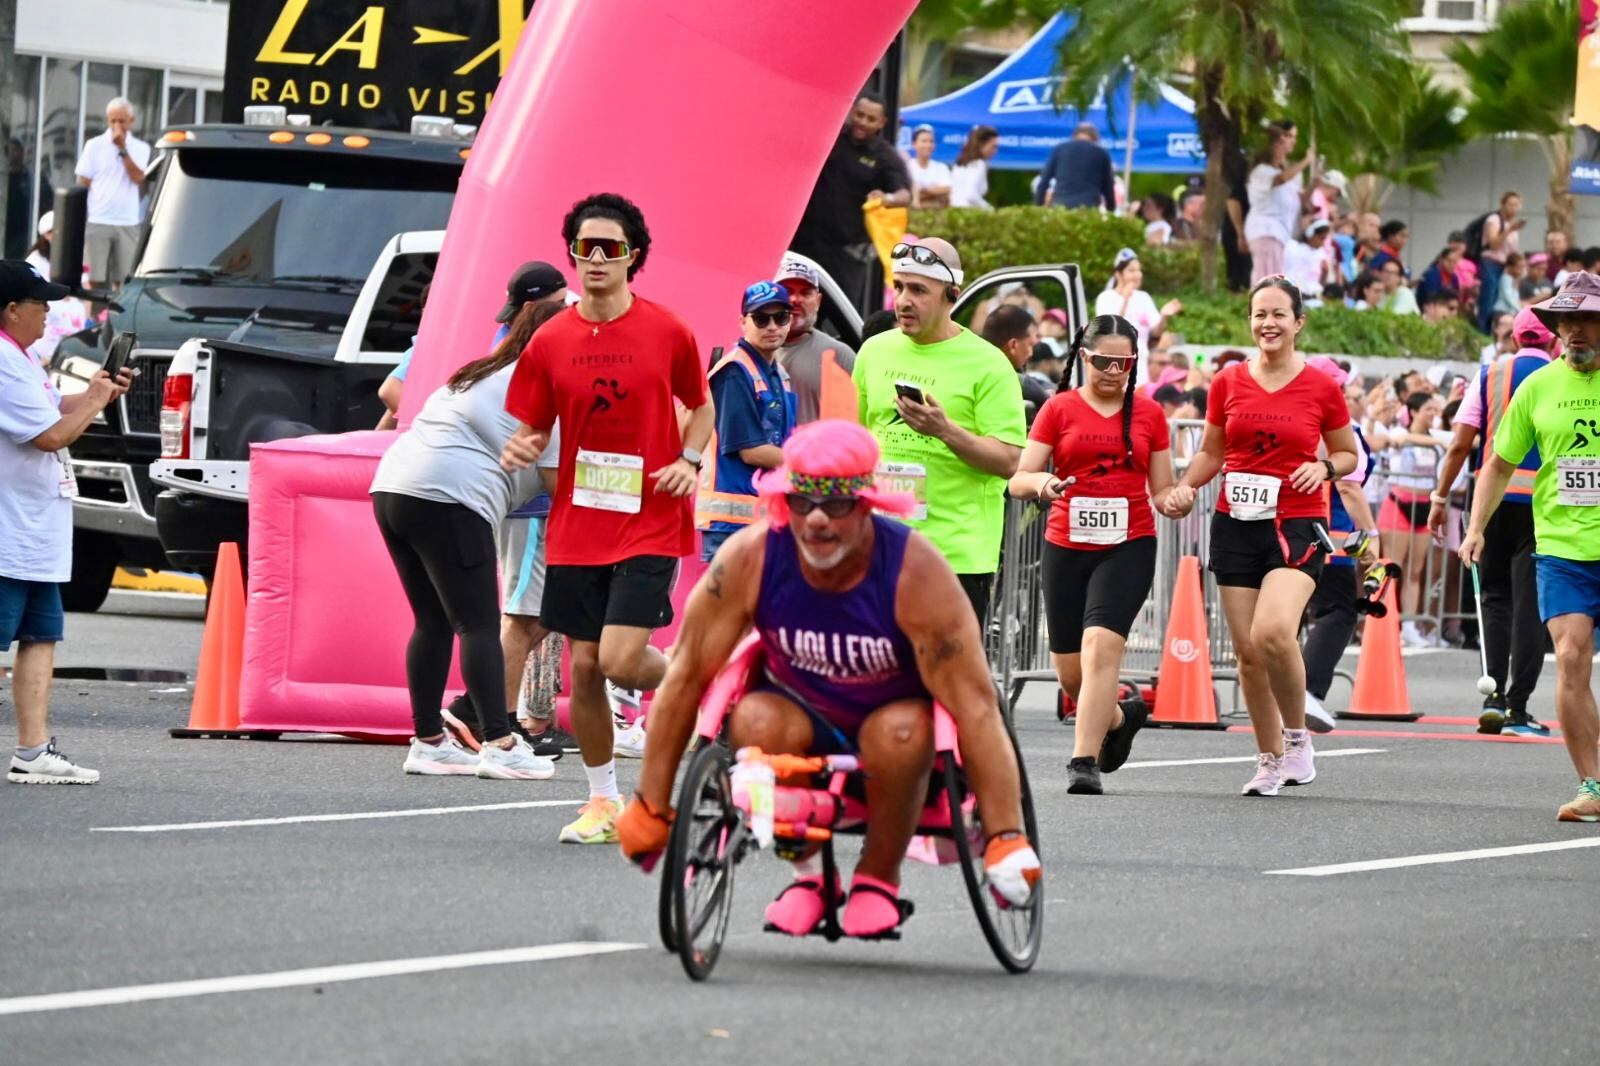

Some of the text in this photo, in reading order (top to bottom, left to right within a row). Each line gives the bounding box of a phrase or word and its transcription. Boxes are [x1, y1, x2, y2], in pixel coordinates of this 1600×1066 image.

[254, 0, 385, 69] LA
[250, 77, 381, 109] RADIO
[572, 353, 634, 366] FEPUDECI
[1079, 434, 1121, 443] FEPUDE
[585, 467, 633, 494] 0022
[1232, 486, 1269, 505] 5514
[1079, 510, 1118, 529] 5501
